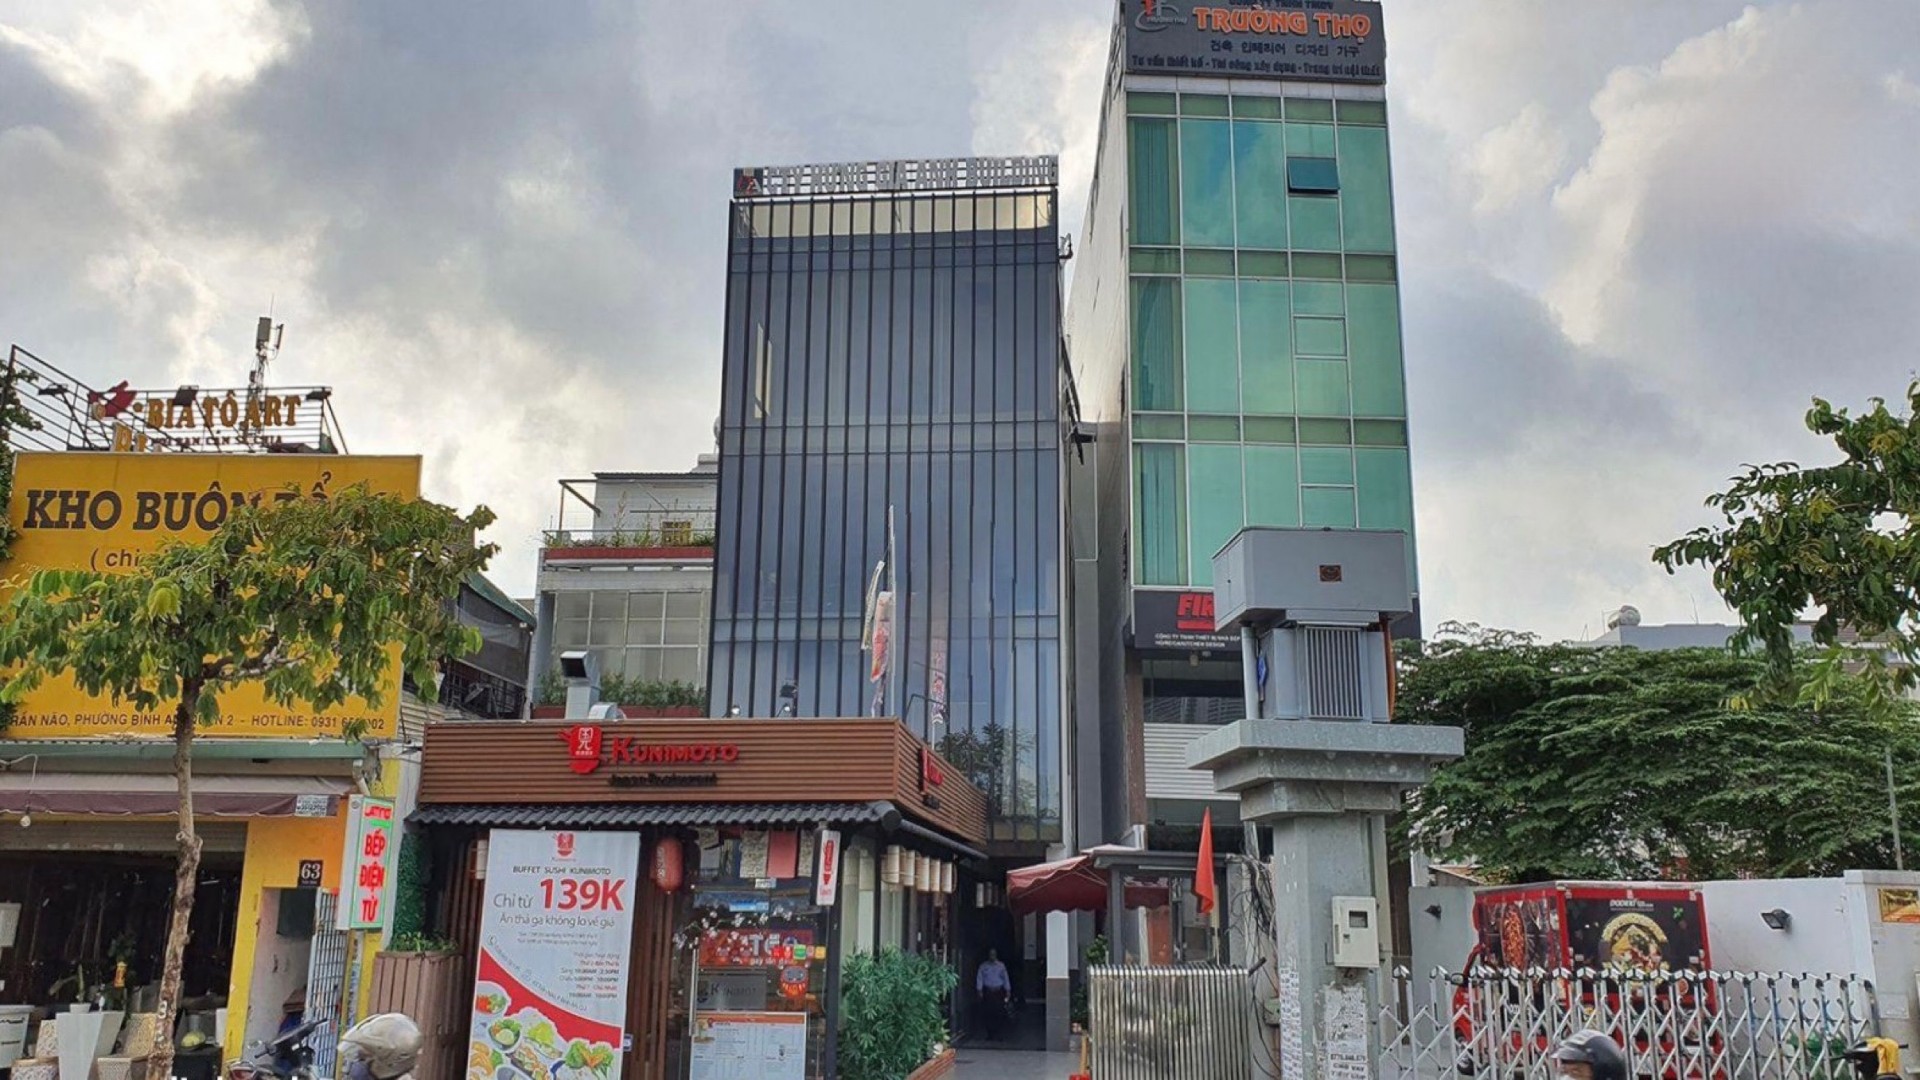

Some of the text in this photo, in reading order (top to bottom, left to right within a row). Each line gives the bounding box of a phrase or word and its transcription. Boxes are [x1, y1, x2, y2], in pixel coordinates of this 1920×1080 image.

[1313, 12, 1372, 43] THỌ
[247, 395, 301, 427] ART
[23, 489, 122, 531] KHO
[226, 714, 234, 726] 2
[364, 828, 386, 857] BẾP
[300, 863, 321, 880] 63
[512, 866, 541, 874] BUFFET
[540, 878, 626, 912] 139K
